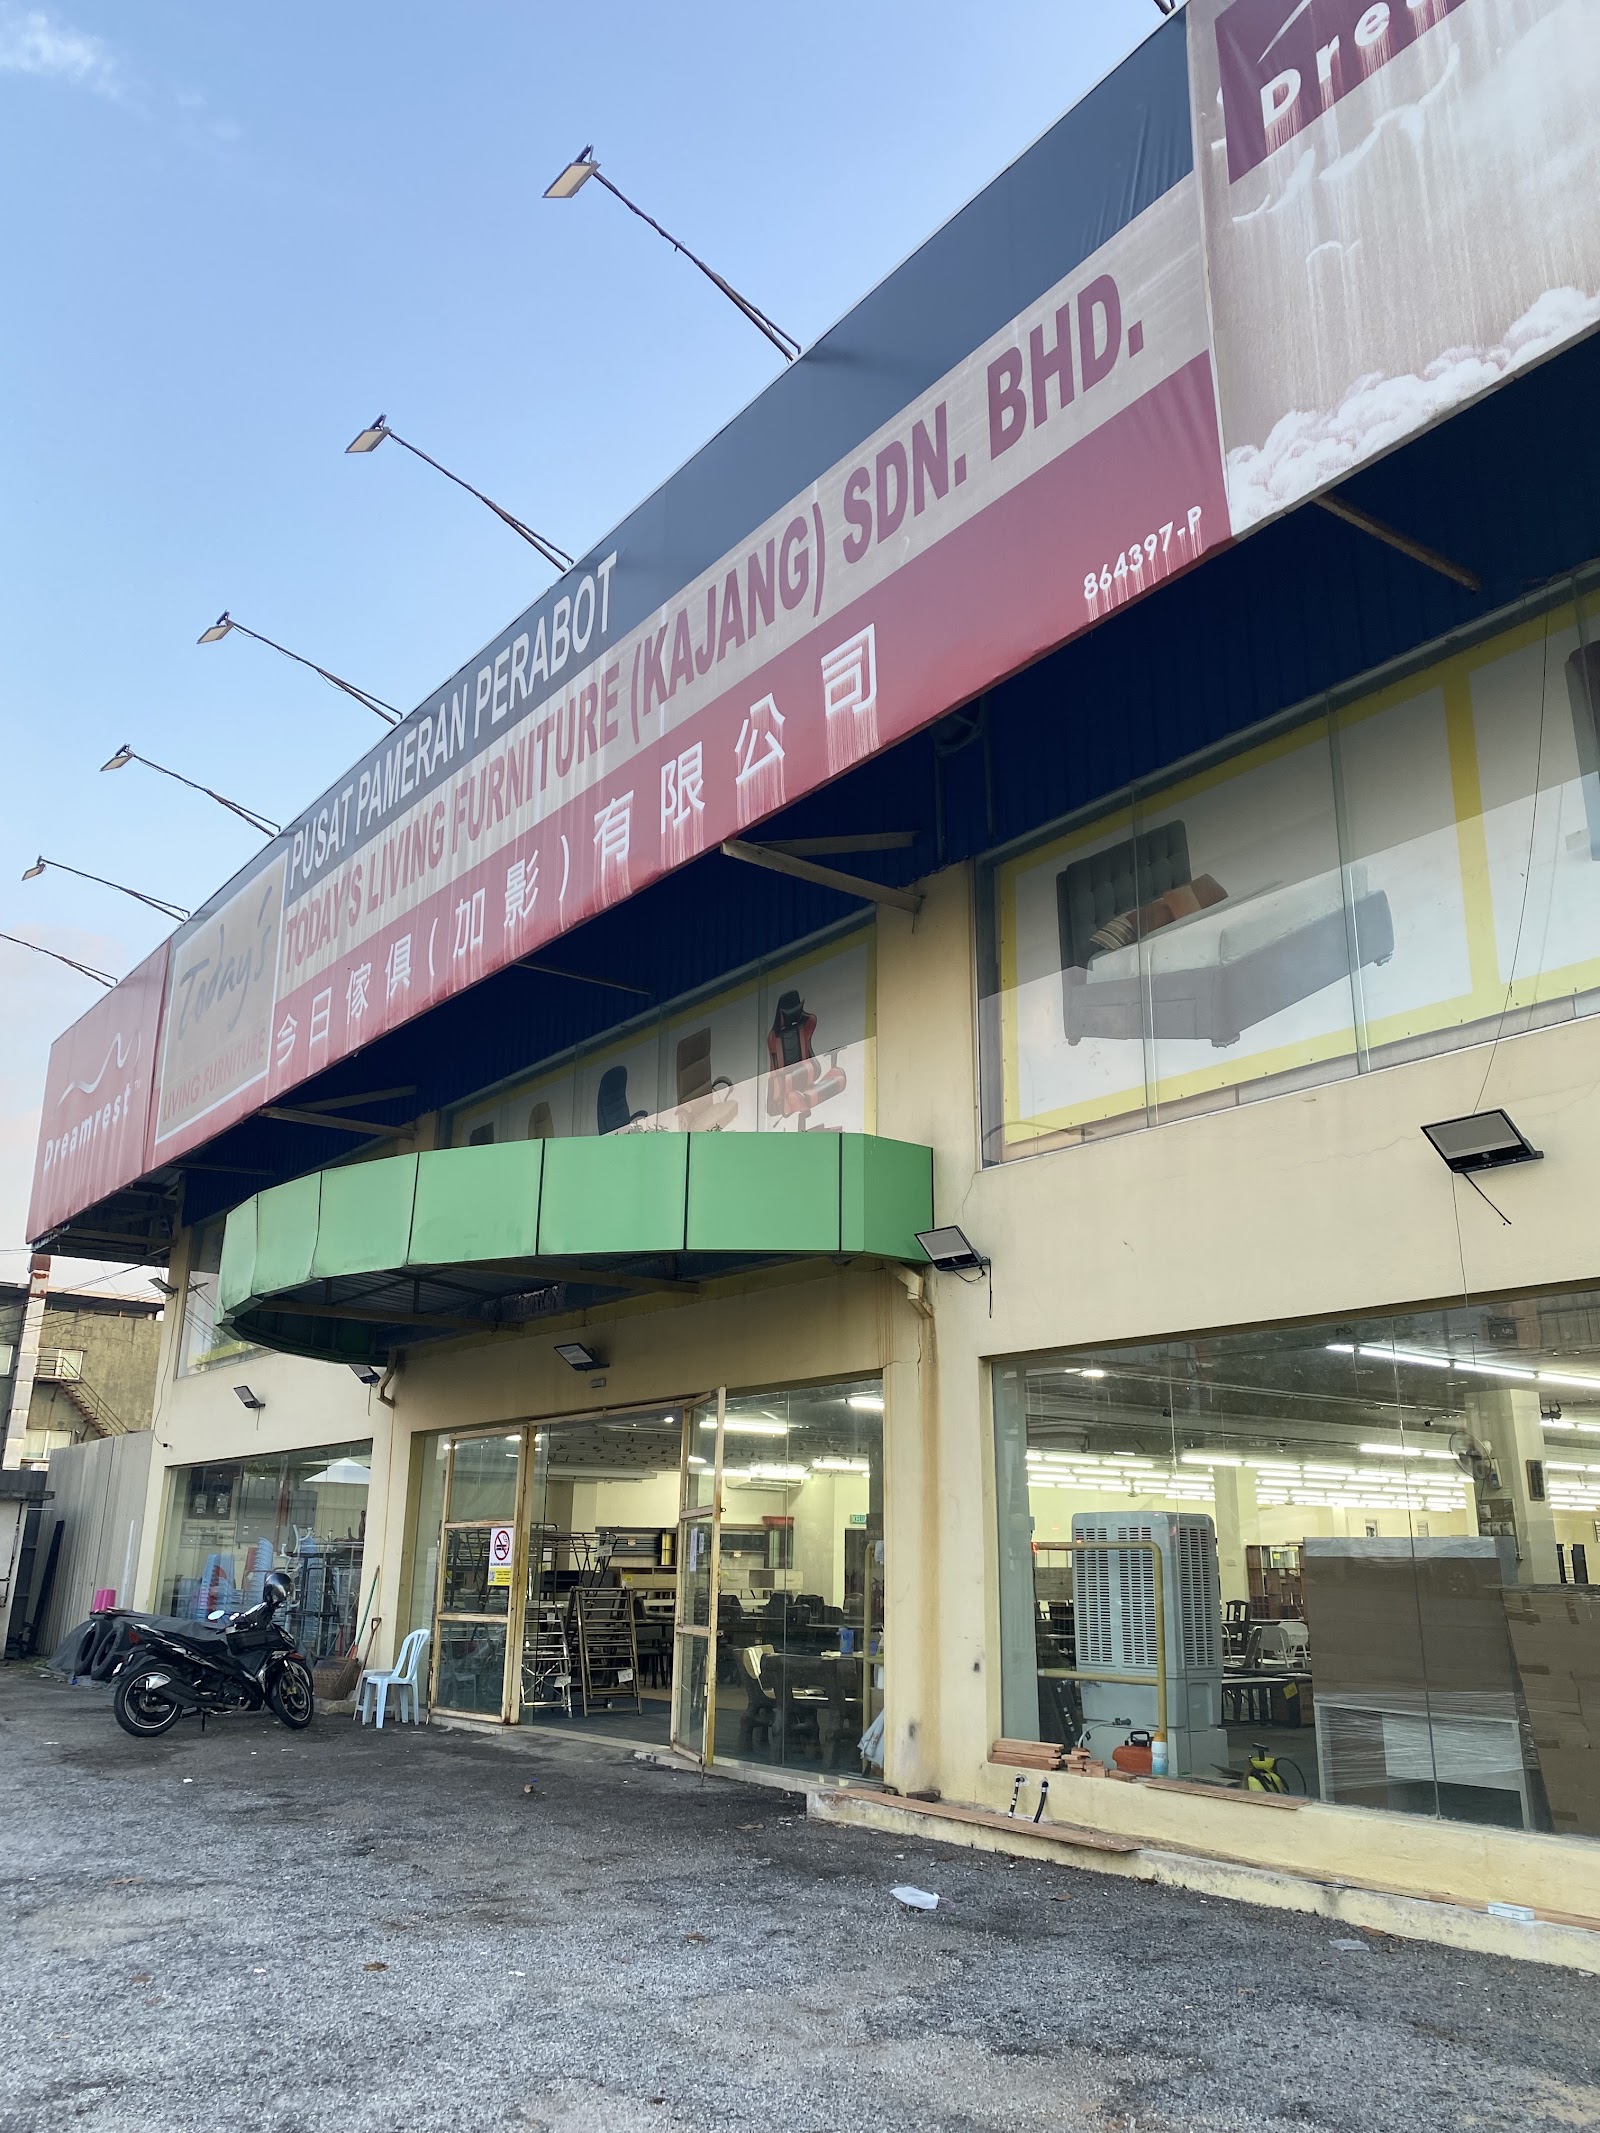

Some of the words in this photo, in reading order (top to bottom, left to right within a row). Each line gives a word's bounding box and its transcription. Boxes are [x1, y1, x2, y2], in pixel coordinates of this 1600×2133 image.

[1260, 0, 1428, 129] Dre
[1083, 505, 1202, 601] 864397-P
[286, 863, 363, 974] TODAY'S
[367, 800, 446, 915] LIVING
[452, 661, 620, 855] FURNITURE
[631, 501, 825, 744] (KAJANG)
[842, 400, 967, 564] SDN.
[987, 274, 1144, 461] BHD.
[290, 787, 353, 890] PUSAT
[356, 683, 468, 836] PAMERAN
[474, 550, 617, 739] PERABOT
[178, 885, 272, 1041] Today's
[44, 1083, 130, 1172] Dreamrest
[162, 1080, 200, 1122] LIVING
[201, 1030, 265, 1092] FURNITURE
